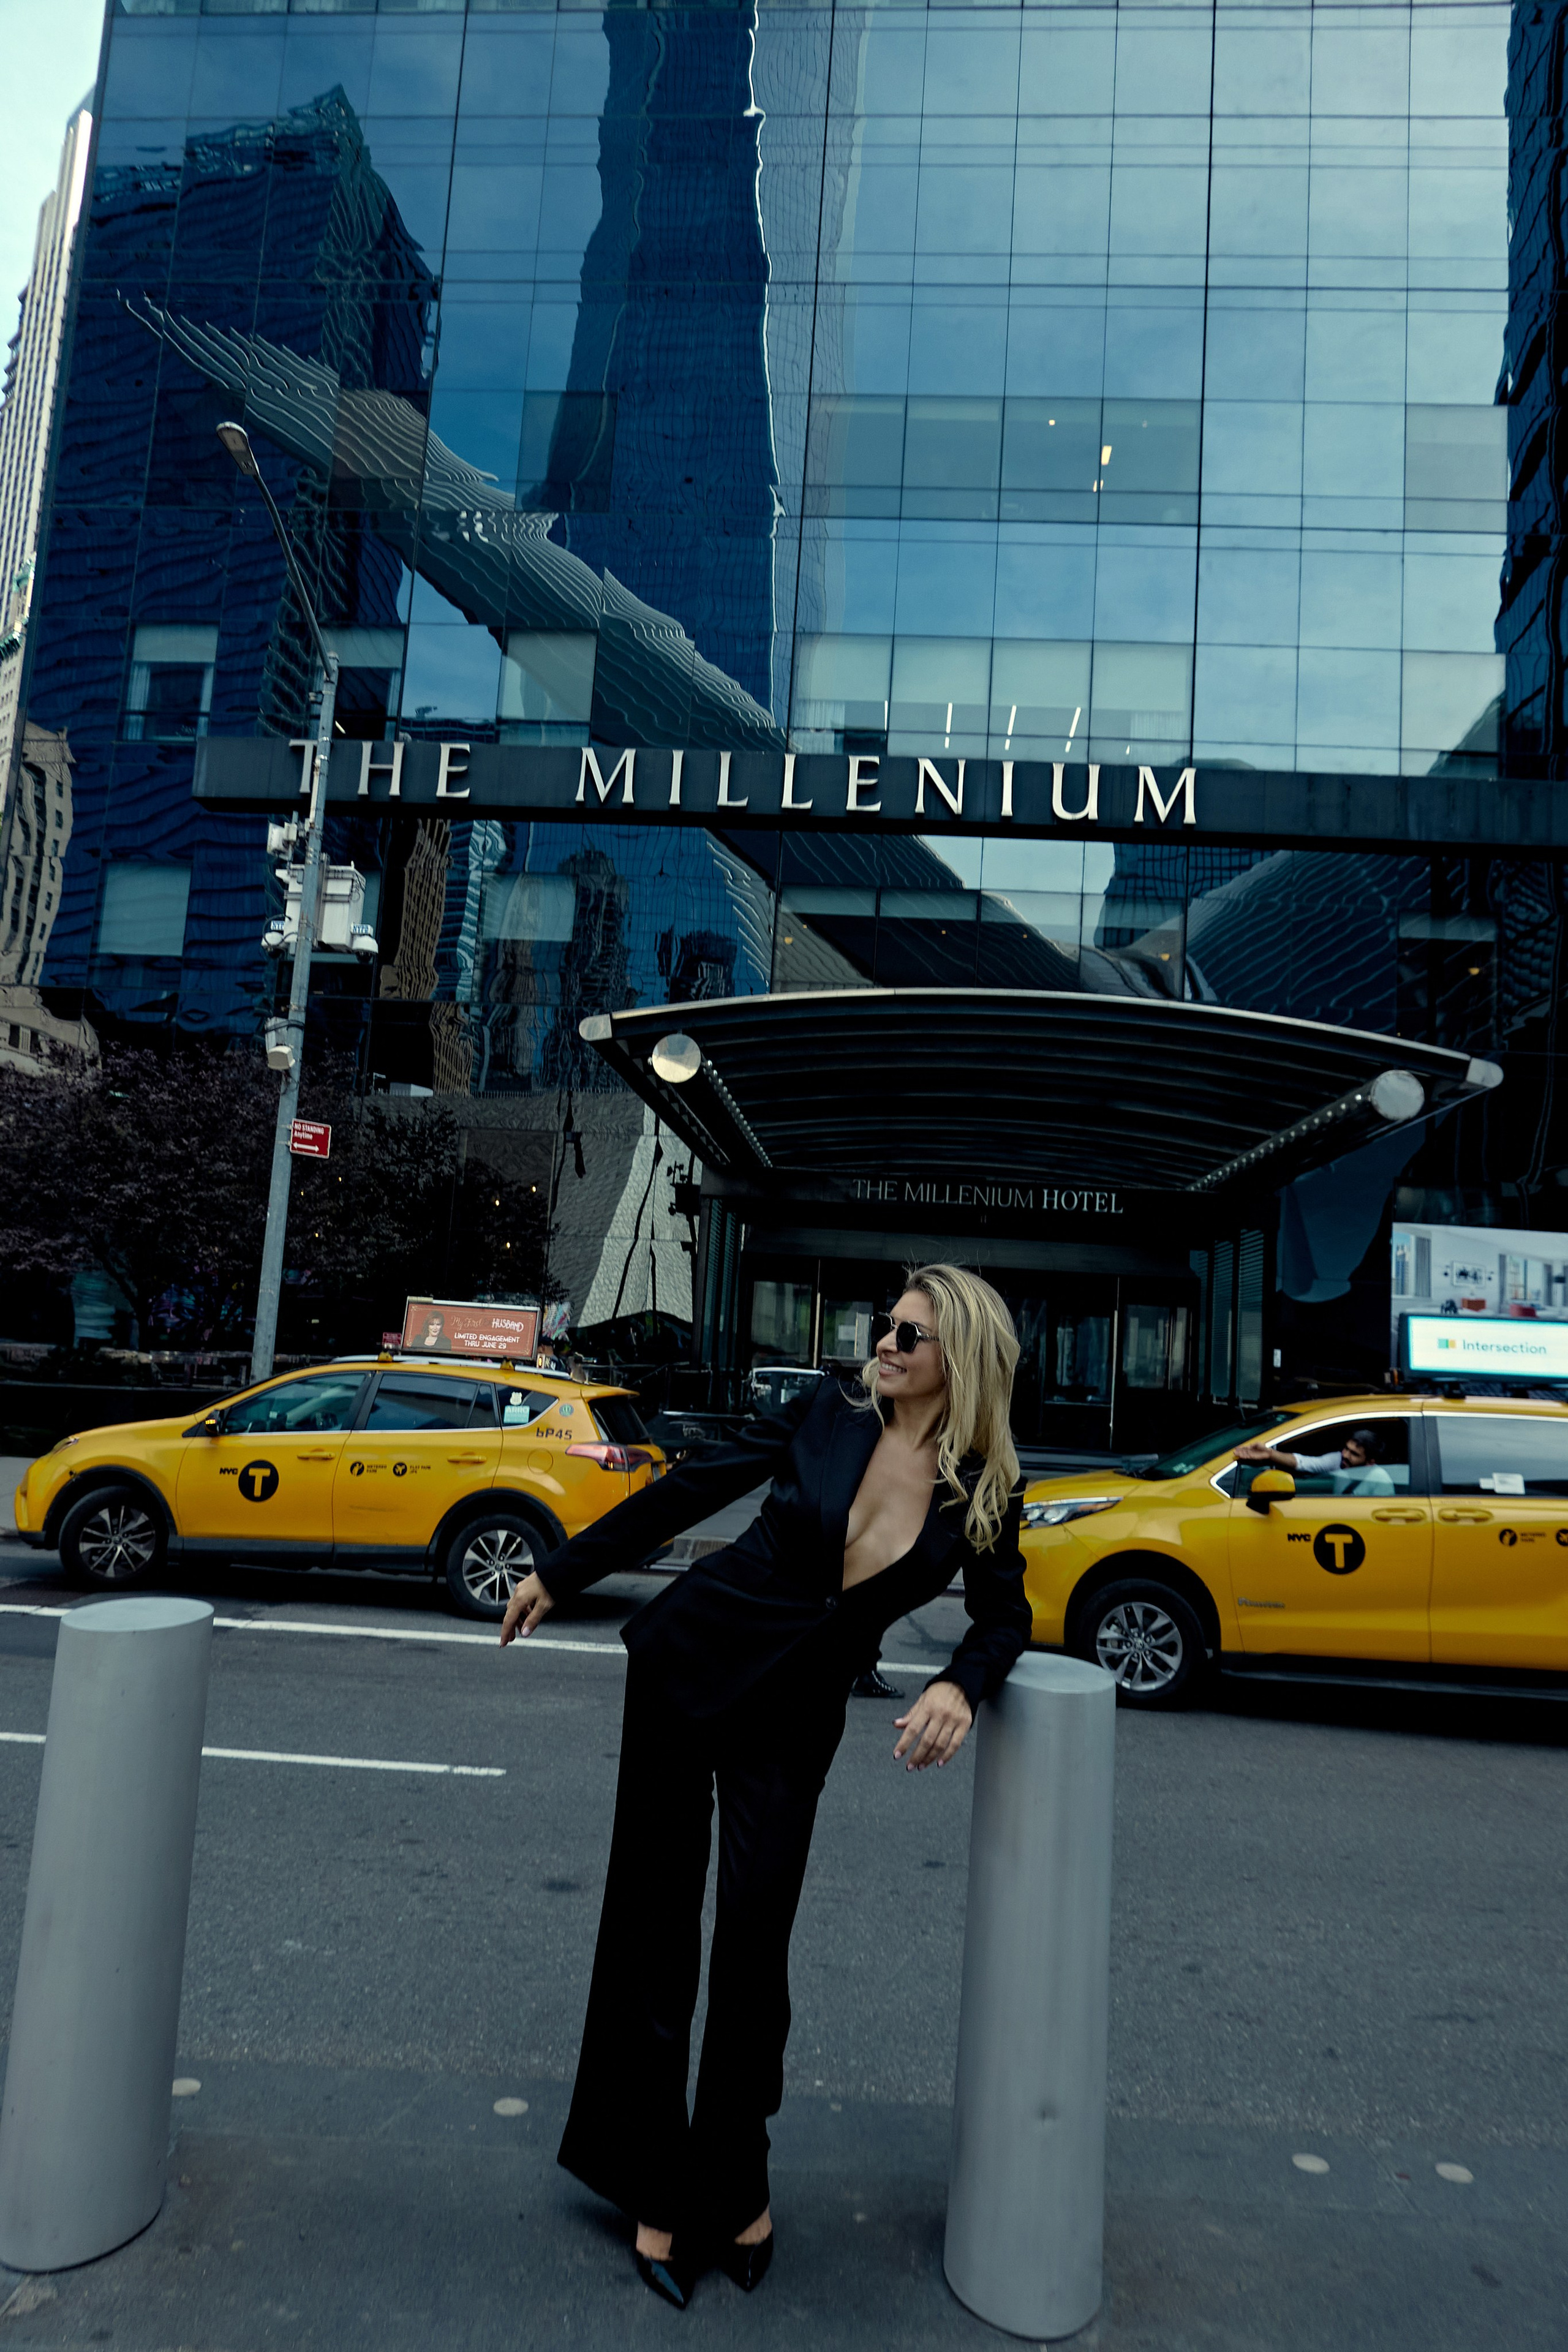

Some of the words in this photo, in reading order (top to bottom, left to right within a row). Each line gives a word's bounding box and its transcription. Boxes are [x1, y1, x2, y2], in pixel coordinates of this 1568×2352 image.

[288, 739, 470, 798] THE
[575, 746, 1196, 824] MILLENIUM
[294, 1130, 313, 1140] Anytime
[302, 1125, 324, 1135] STANDING
[853, 1178, 897, 1201] THE
[905, 1182, 1033, 1209] MILLENIUM
[1042, 1188, 1123, 1214] HOTEL
[492, 1317, 524, 1332] HUSBAND
[479, 1334, 520, 1343] ENGAGEMENT
[1463, 1340, 1547, 1354] Intersection
[1287, 1533, 1311, 1542] NYC
